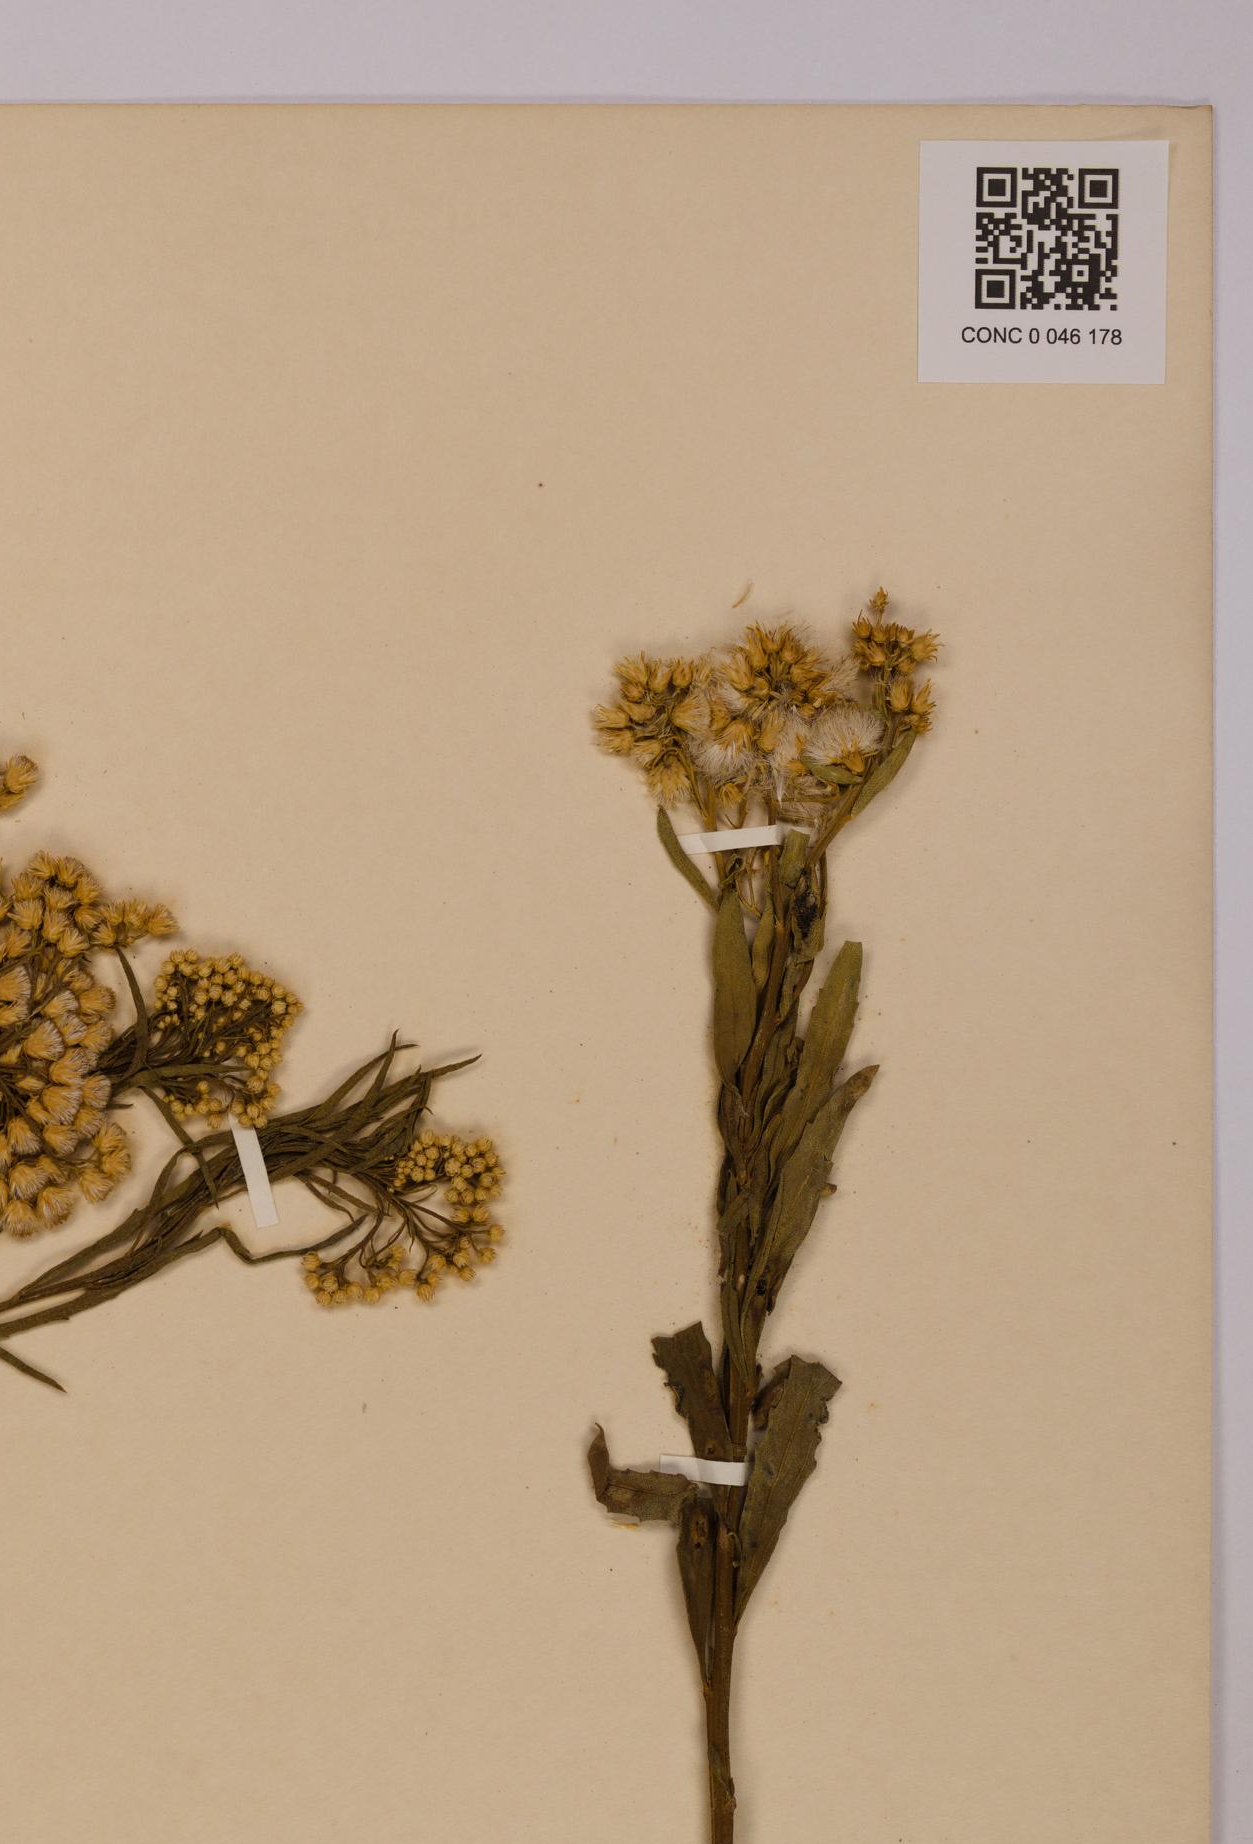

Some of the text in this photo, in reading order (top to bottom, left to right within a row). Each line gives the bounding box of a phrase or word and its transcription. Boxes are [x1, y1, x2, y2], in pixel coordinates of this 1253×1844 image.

[961, 326, 1123, 346] CONC 0 046 178
